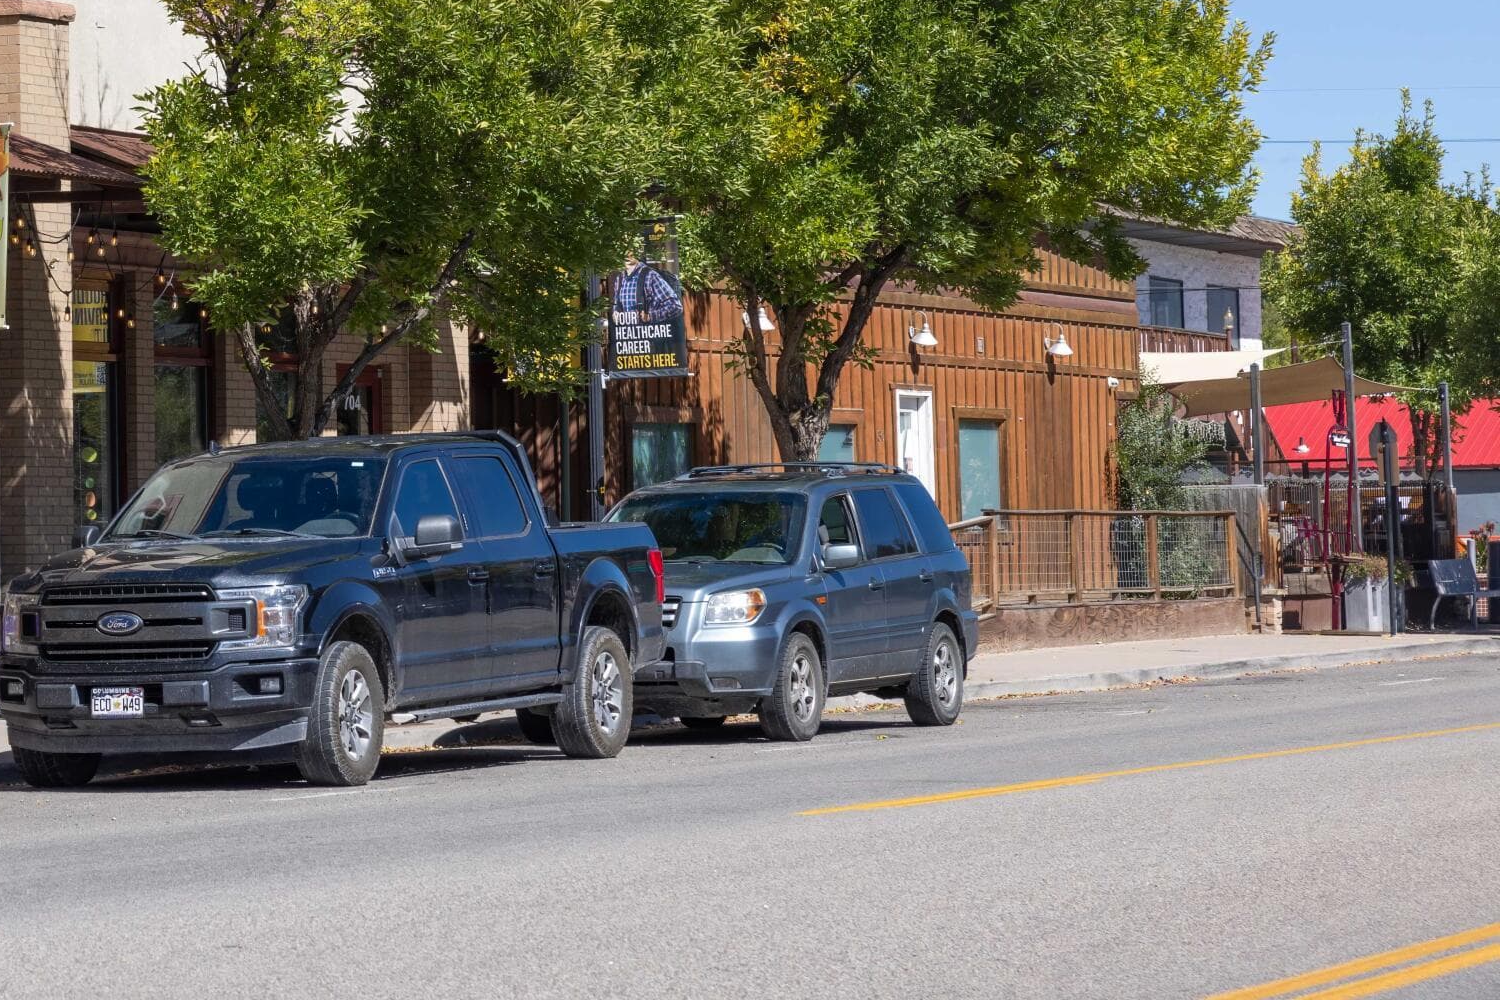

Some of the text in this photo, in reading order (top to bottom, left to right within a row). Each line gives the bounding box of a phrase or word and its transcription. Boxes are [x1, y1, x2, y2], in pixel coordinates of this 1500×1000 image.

[615, 311, 638, 326] YOUR
[616, 324, 673, 340] HEALTHCARE
[616, 340, 651, 355] CAREER
[616, 353, 679, 370] STARTS HERE.
